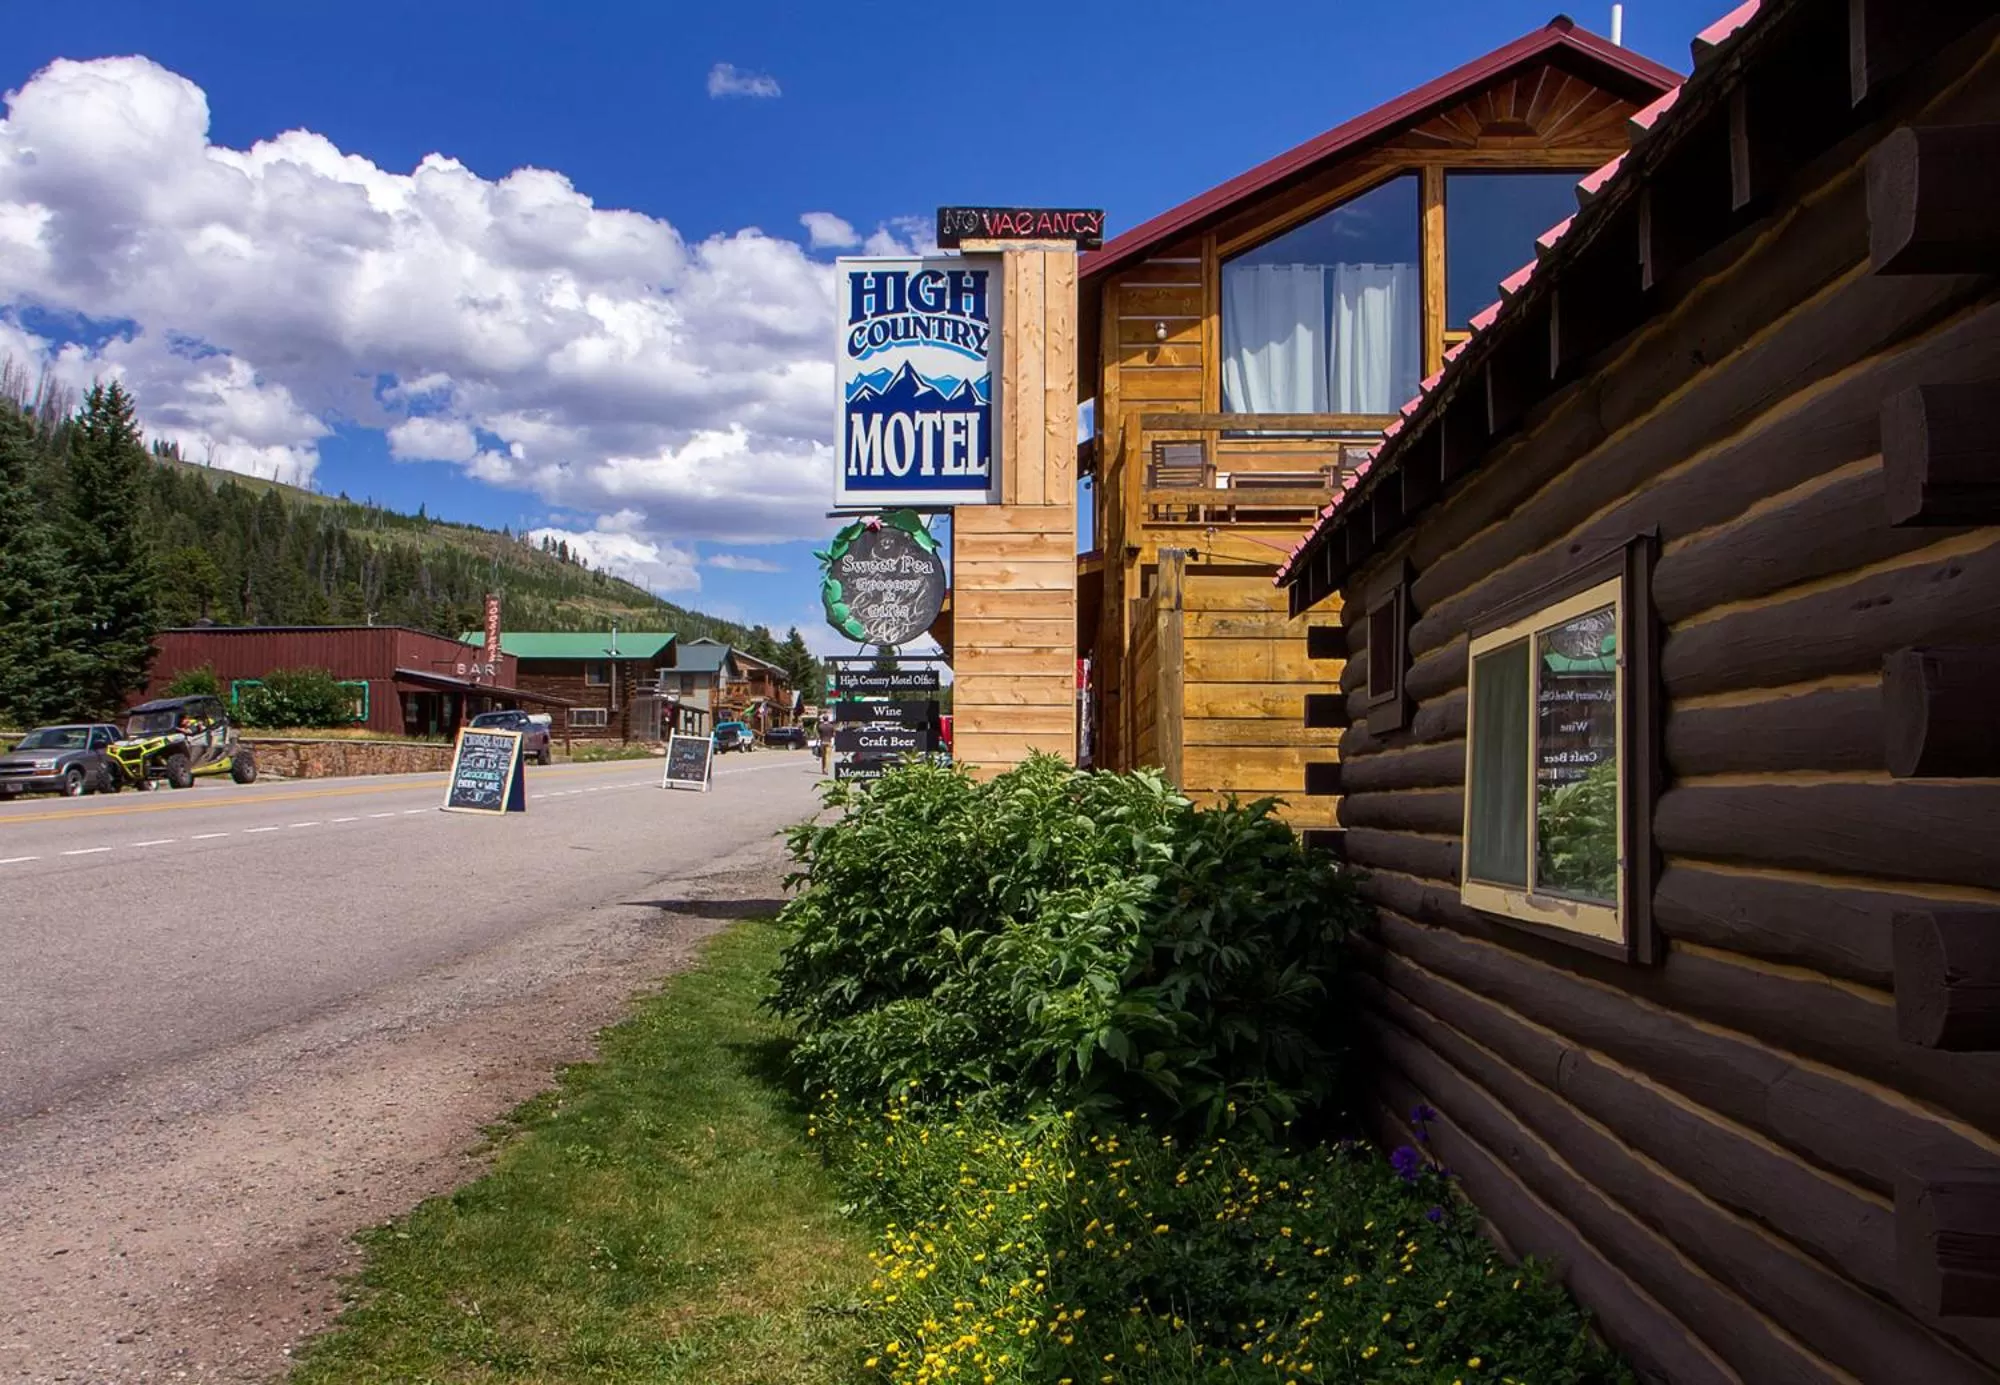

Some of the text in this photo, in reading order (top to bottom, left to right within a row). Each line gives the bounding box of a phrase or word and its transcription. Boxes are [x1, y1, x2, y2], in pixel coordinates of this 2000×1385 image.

[944, 210, 1105, 236] NO VACANCY
[848, 270, 990, 322] HIGH
[848, 316, 991, 358] COUNTRY
[848, 410, 990, 477] MOTEL
[842, 554, 934, 574] Sweet Pea
[457, 663, 496, 676] BAR
[840, 674, 936, 688] High Country Motel Office
[873, 706, 902, 717] Wine
[859, 736, 915, 747] Craft Beer
